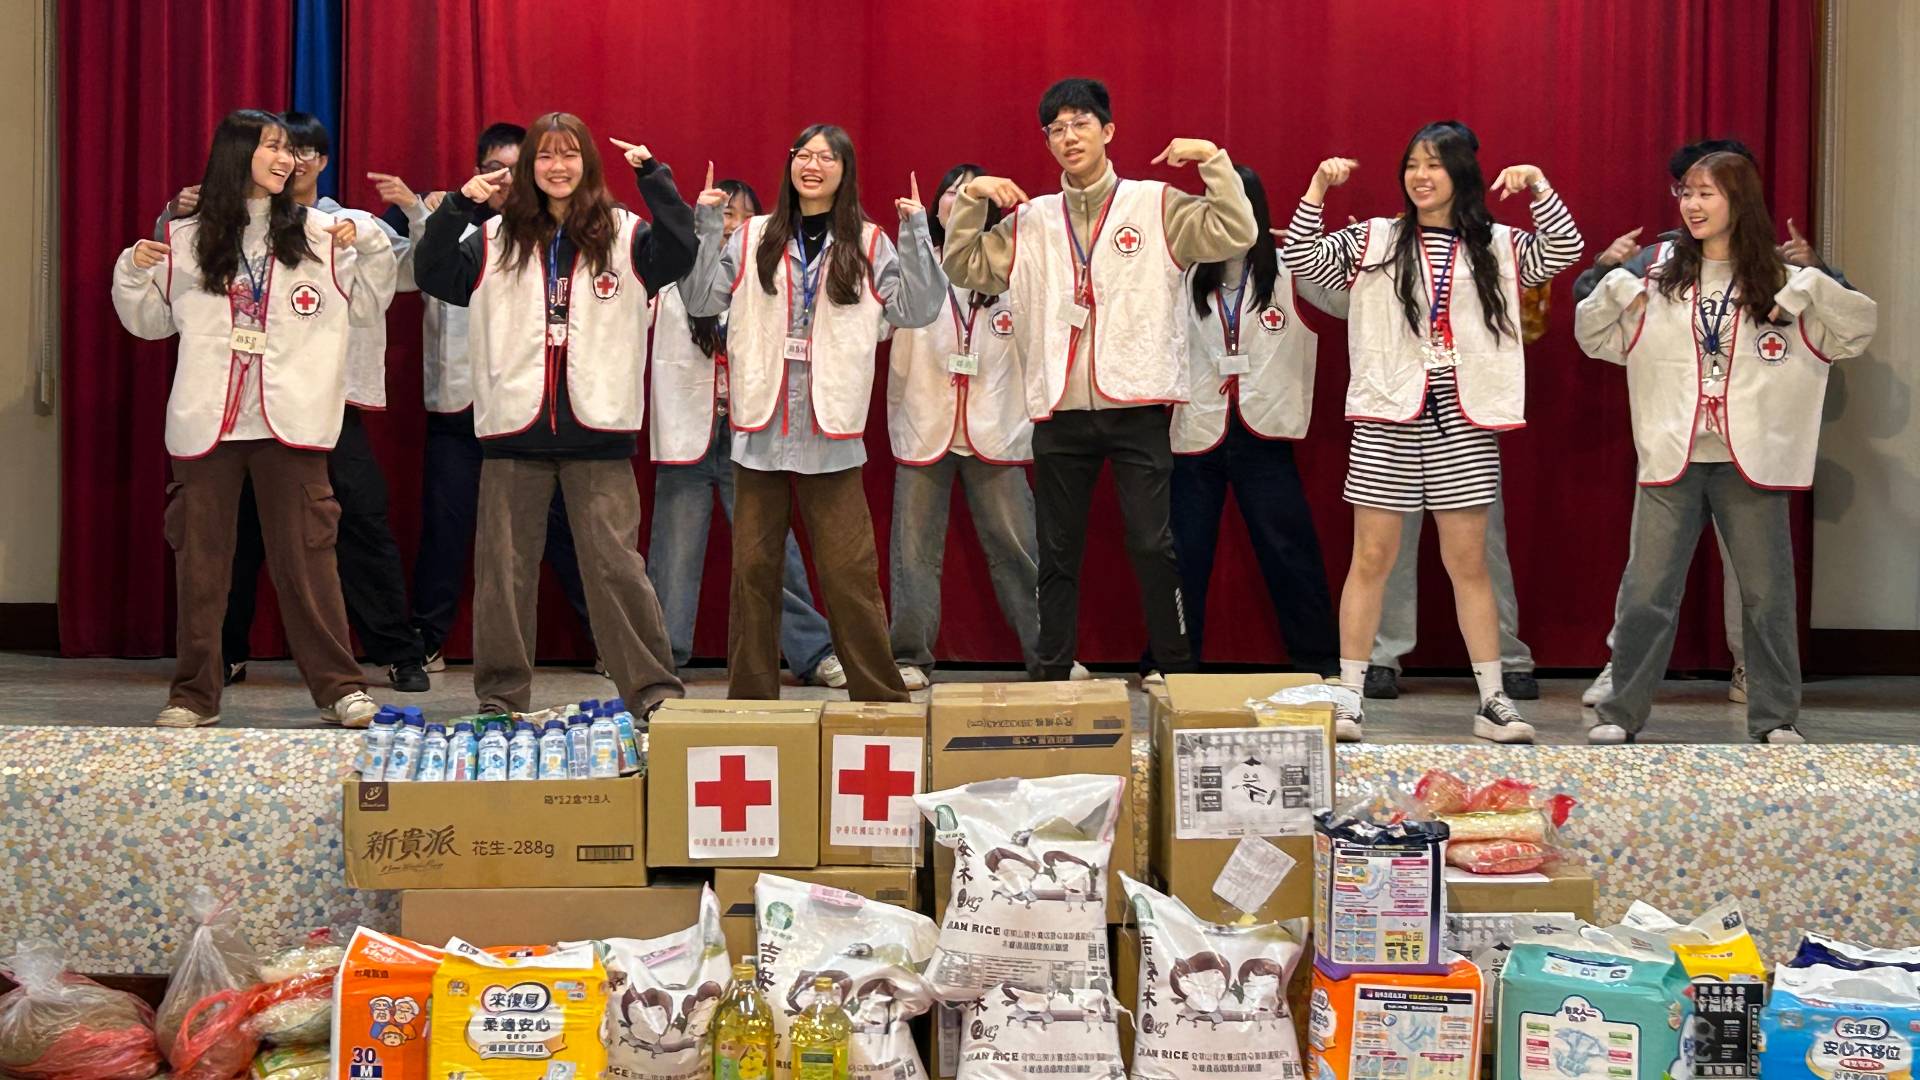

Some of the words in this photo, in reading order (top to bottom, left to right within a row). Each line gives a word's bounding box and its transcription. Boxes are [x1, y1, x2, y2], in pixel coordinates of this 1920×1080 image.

[361, 824, 462, 864] 新貴派
[472, 840, 554, 858] 花生-288g
[972, 923, 1001, 936] RICE
[353, 1047, 377, 1064] 30
[993, 1051, 1019, 1061] RICE
[1162, 1049, 1189, 1061] RICE
[360, 1065, 374, 1078] M
[608, 1065, 628, 1078] ICE
[775, 1060, 792, 1070] RIC
